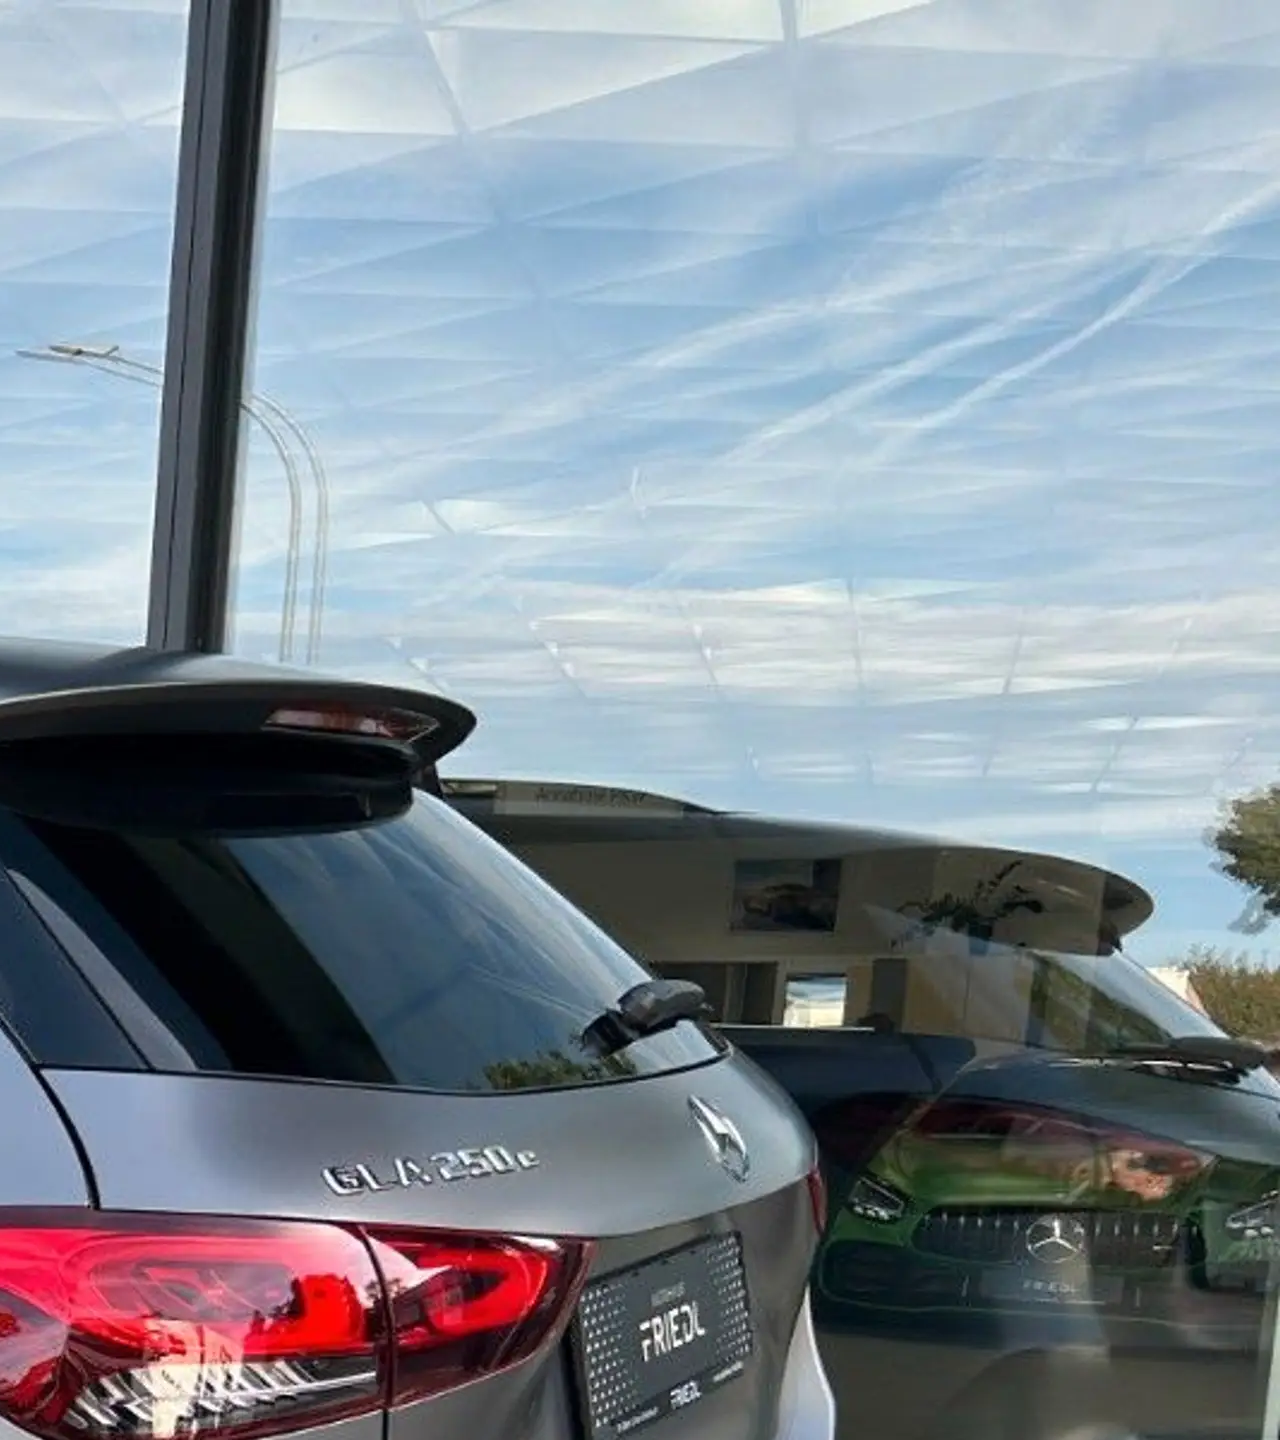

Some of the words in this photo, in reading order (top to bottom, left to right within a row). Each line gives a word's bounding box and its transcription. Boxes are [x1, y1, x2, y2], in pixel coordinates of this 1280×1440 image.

[321, 1155, 431, 1195] GLA
[430, 1145, 540, 1181] 250e
[639, 1301, 706, 1362] FRIEDL
